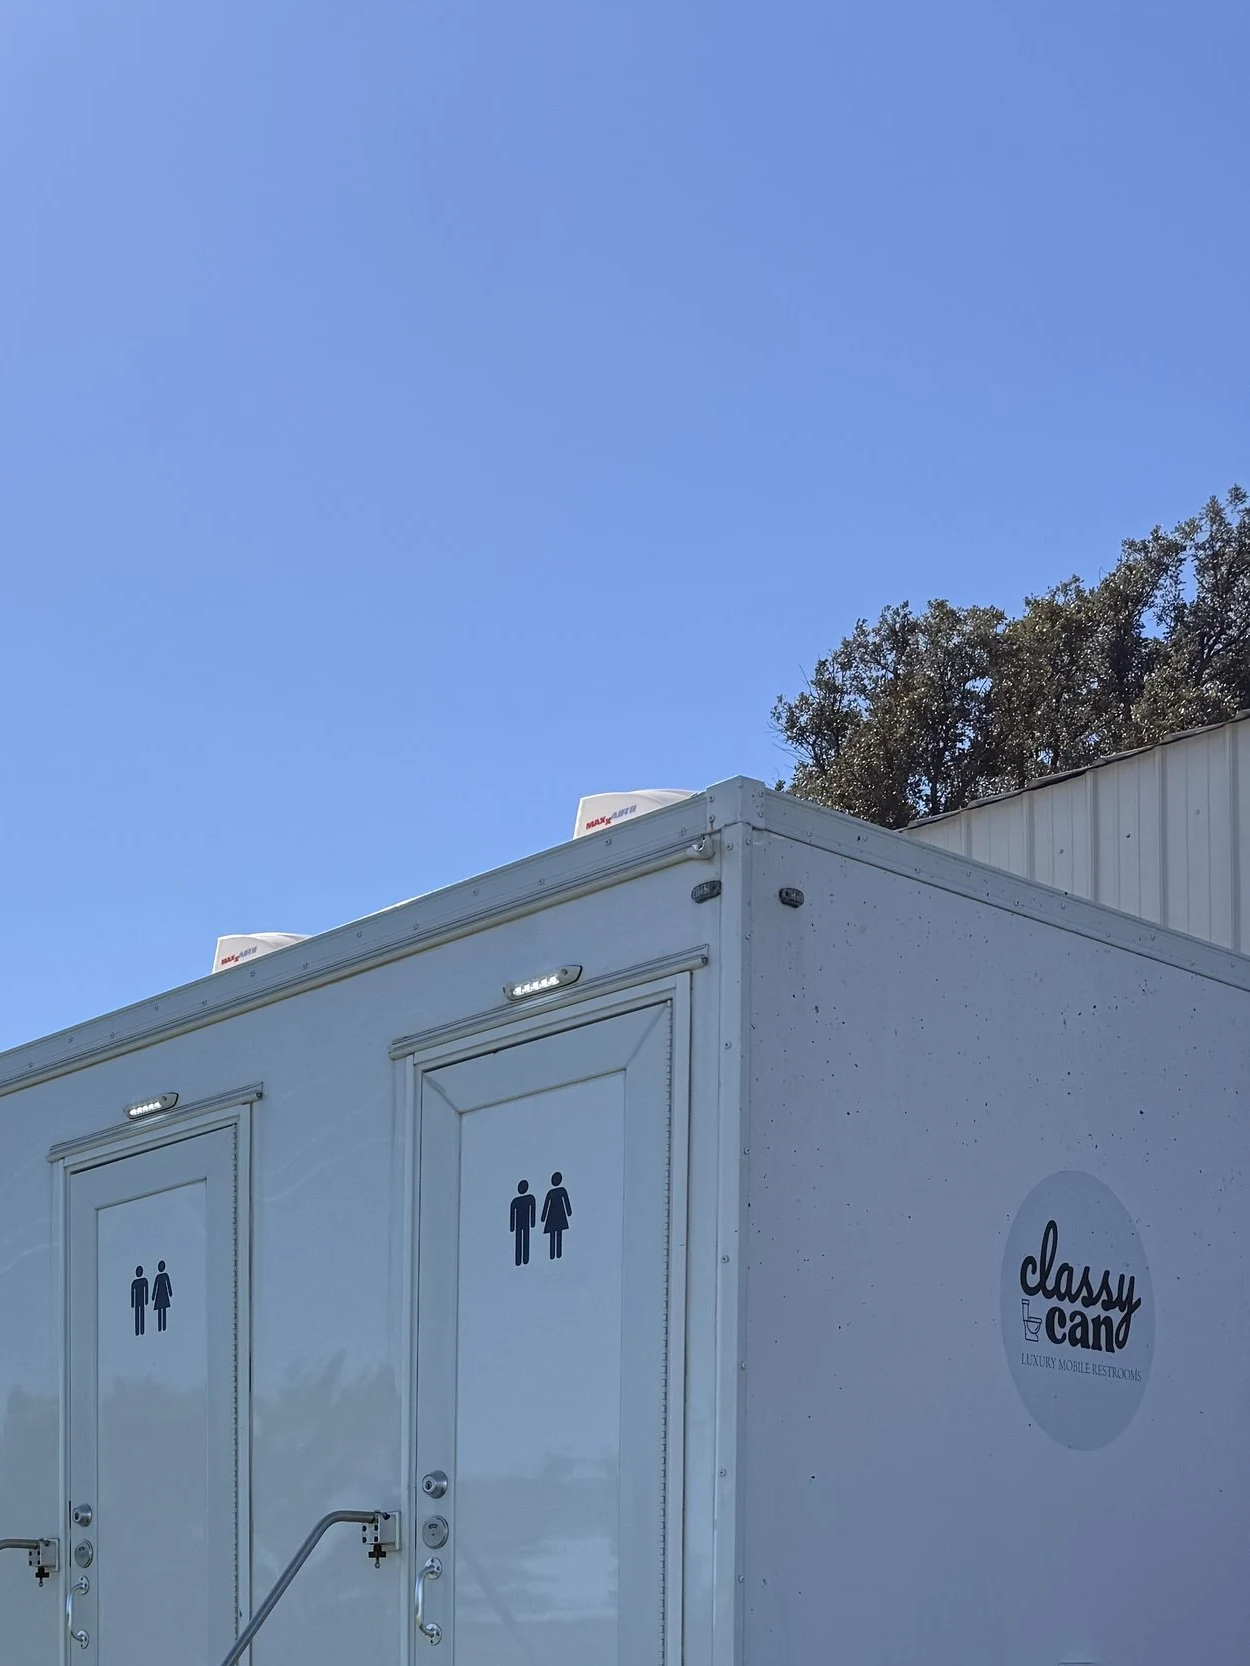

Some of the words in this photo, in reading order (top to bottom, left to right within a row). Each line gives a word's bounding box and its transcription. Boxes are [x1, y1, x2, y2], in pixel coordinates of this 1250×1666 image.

[1020, 1220, 1142, 1350] classy
[1045, 1306, 1116, 1353] can
[1021, 1353, 1056, 1369] LUXURY
[1058, 1359, 1090, 1375] MOBILE
[1092, 1363, 1142, 1382] RESTROOMS
